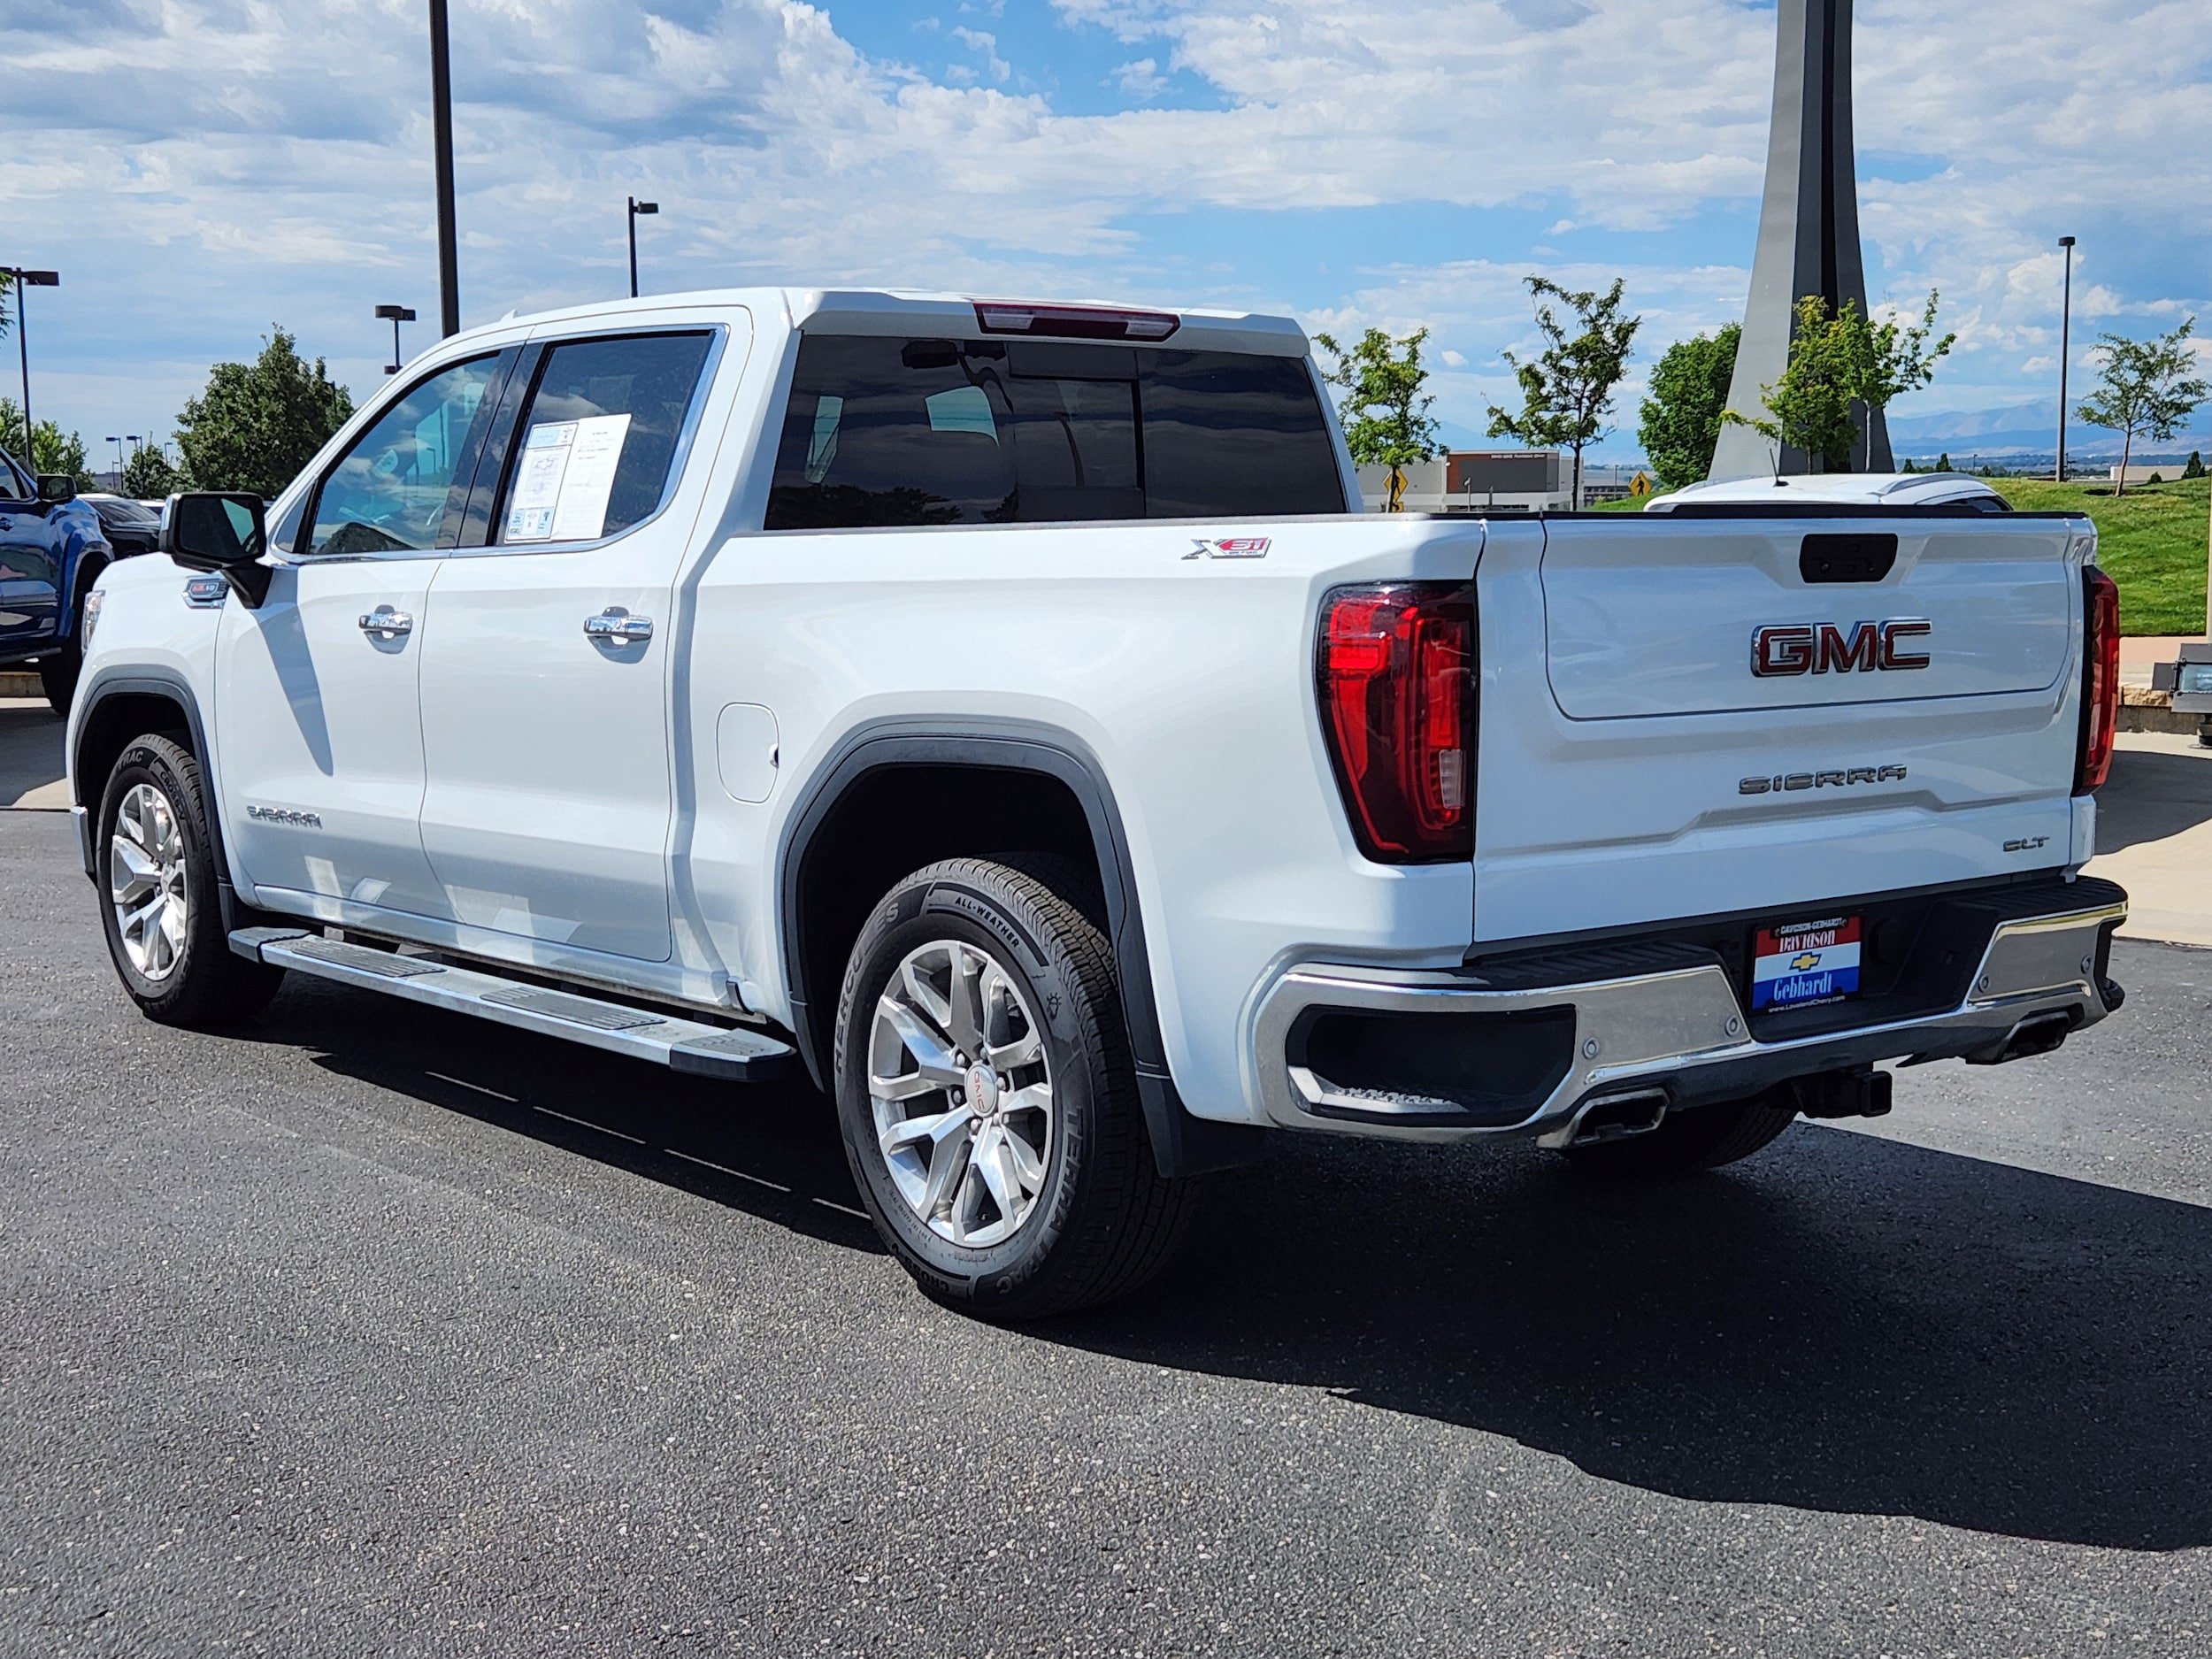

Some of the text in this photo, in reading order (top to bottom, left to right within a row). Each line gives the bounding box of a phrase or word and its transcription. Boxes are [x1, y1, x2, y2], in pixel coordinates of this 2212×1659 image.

[1750, 617, 1932, 678] GMC
[1739, 764, 1907, 795] SIERRA
[2002, 836, 2051, 852] SLT
[974, 1071, 985, 1110] GMC
